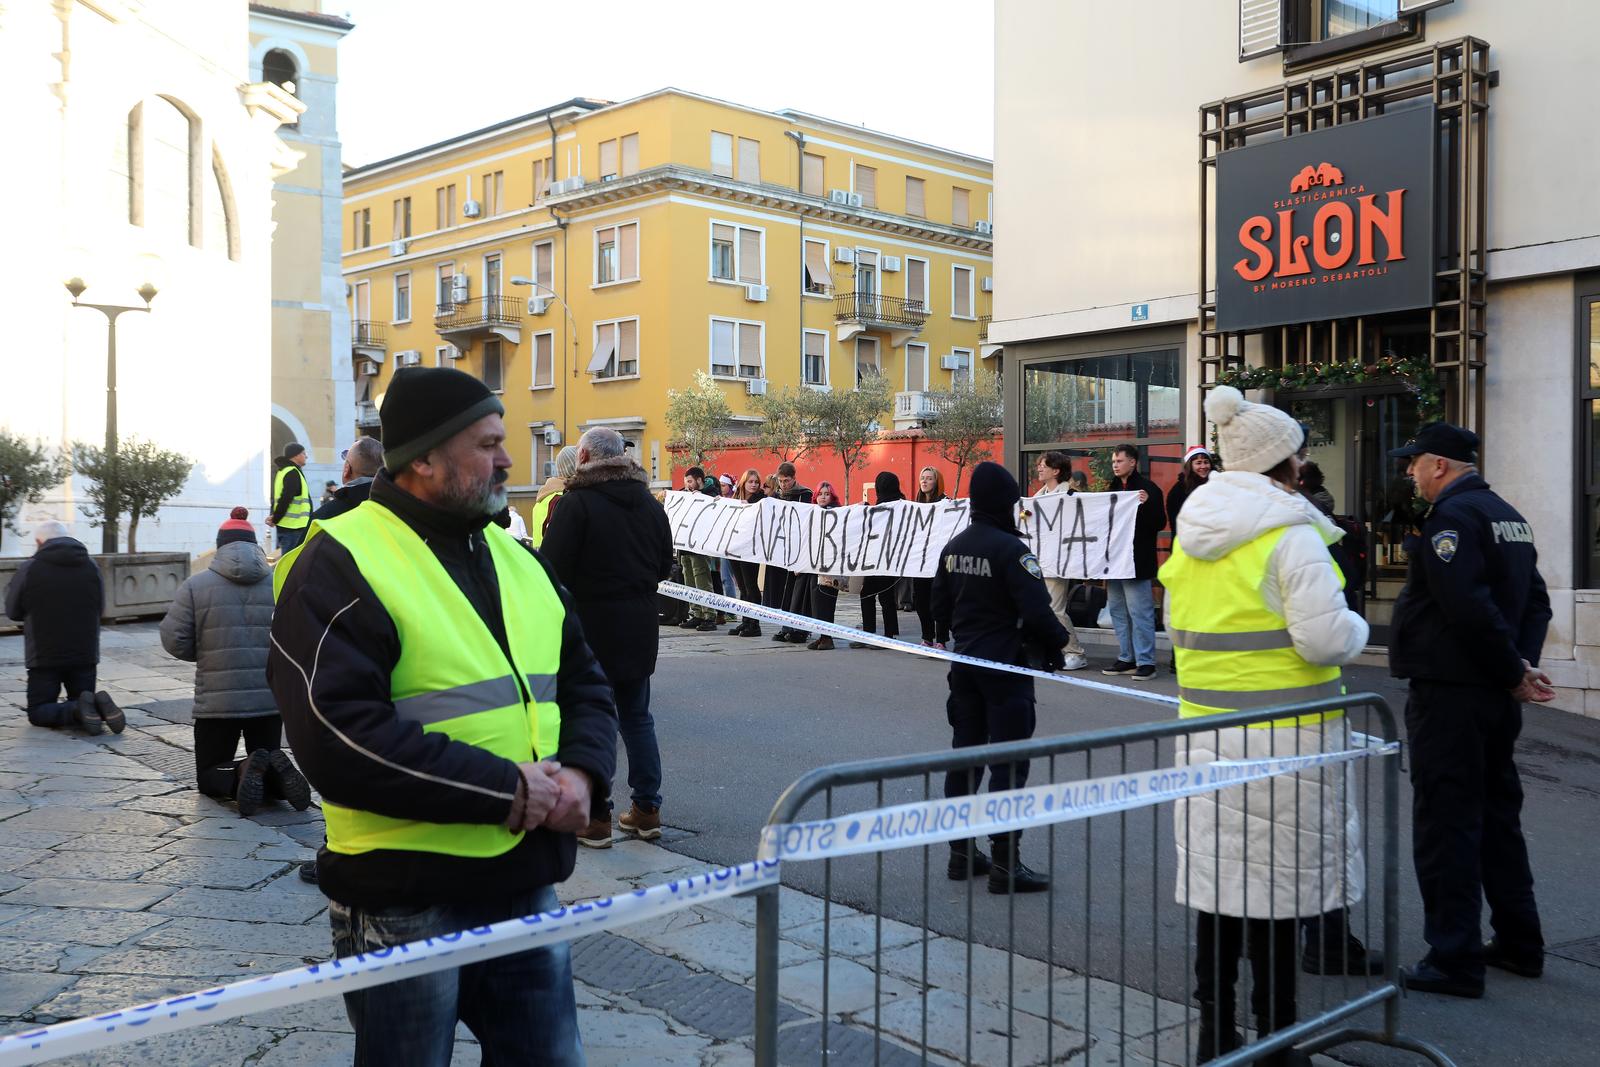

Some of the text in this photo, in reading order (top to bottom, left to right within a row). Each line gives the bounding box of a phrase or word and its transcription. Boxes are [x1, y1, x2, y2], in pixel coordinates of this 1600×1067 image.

[1233, 188, 1408, 281] SLON
[1253, 267, 1387, 293] BY MORENO DEBARTOLI
[1135, 305, 1143, 316] 4
[752, 502, 802, 567] NAD
[809, 504, 935, 575] UBIJENIM
[1491, 521, 1534, 543] POLICIJ
